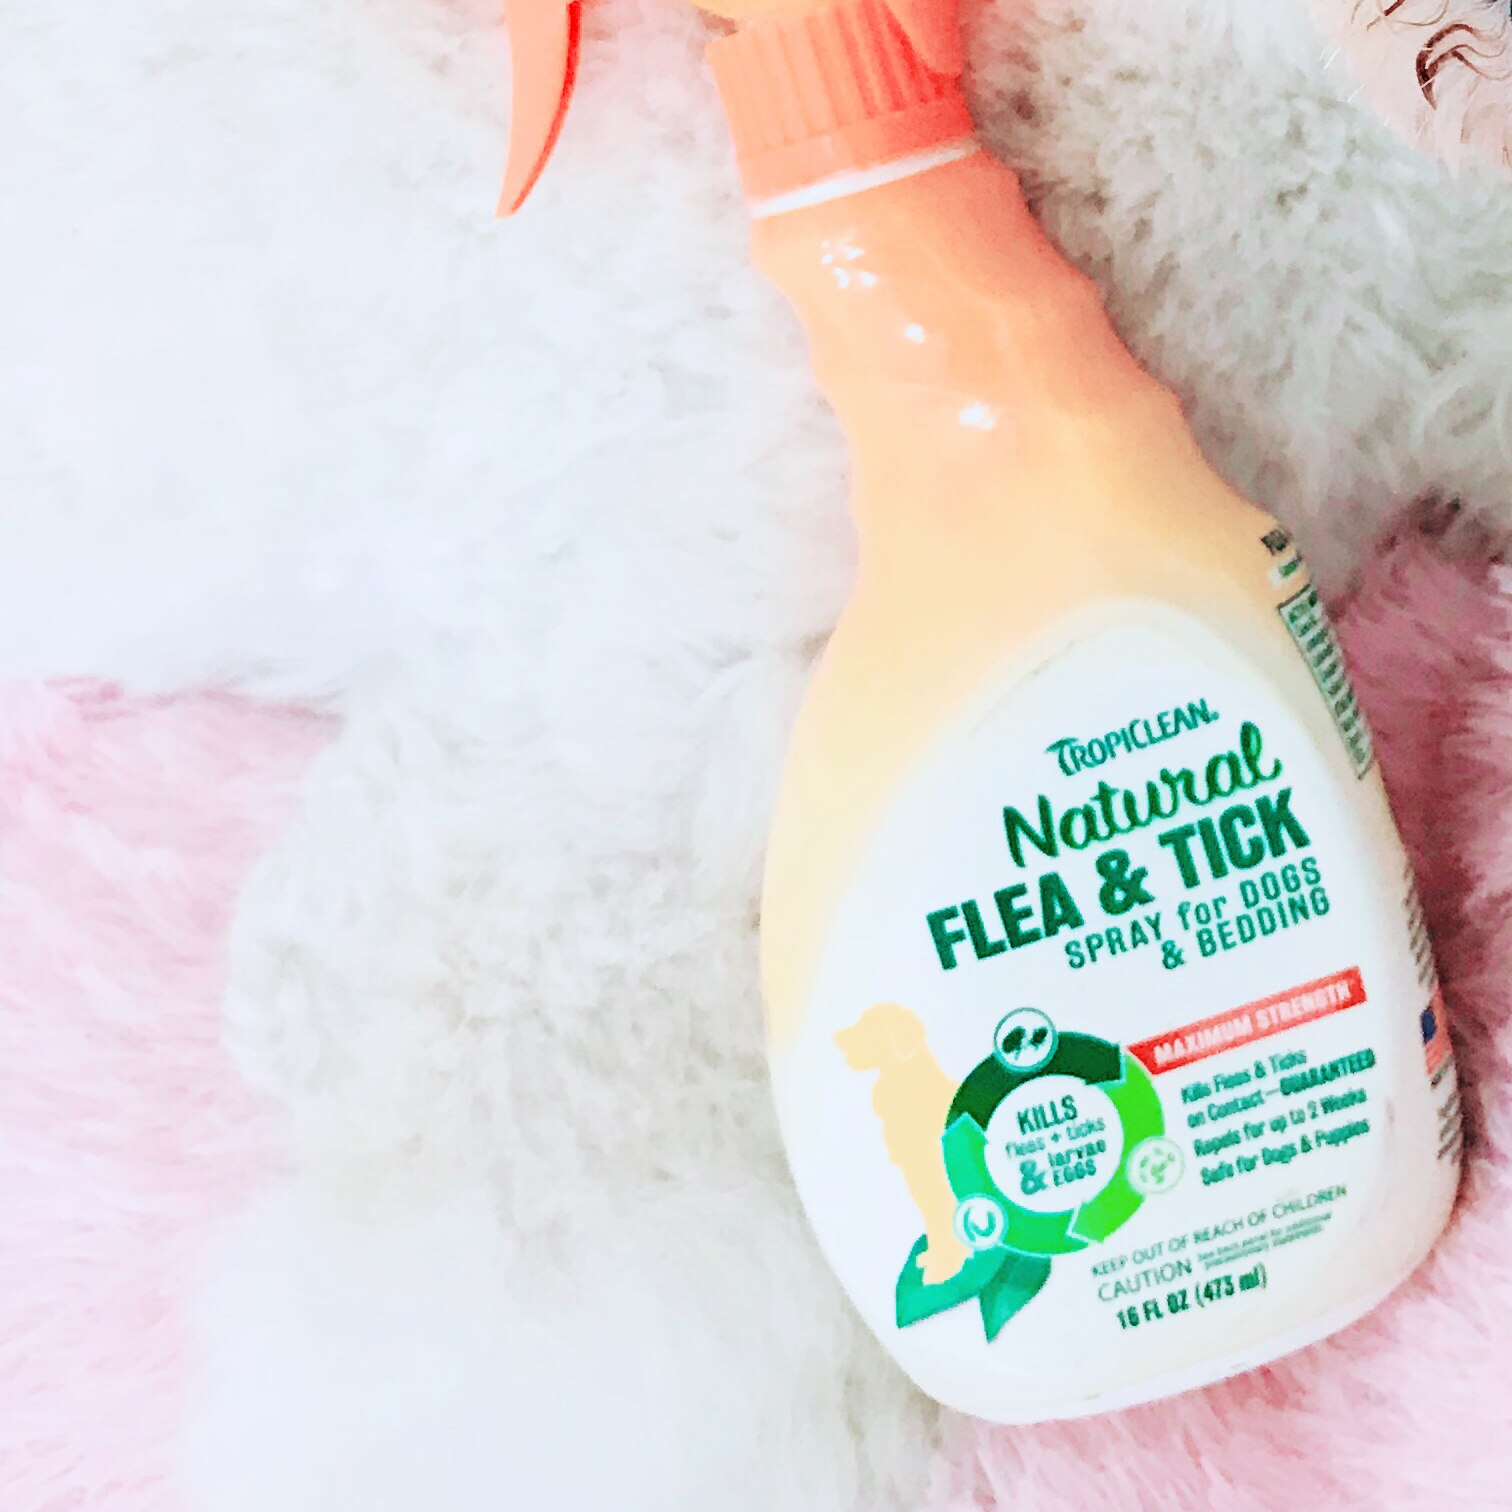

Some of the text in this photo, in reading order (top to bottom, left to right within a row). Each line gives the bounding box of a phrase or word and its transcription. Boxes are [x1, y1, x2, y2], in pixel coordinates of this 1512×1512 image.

[1003, 721, 1282, 868] Natural
[926, 787, 1310, 969] FLEA & TICK
[1064, 857, 1321, 968] SPRAY for DOGS
[1161, 887, 1330, 970] & BEDDING
[1154, 982, 1351, 1065] MAXIMUM STRENGTH
[1254, 1060, 1266, 1079] &
[1017, 1094, 1078, 1135] KILLS
[1187, 1111, 1205, 1128] on
[1243, 1120, 1265, 1141] for
[1269, 1114, 1287, 1134] up
[1289, 1108, 1305, 1125] to
[1307, 1100, 1318, 1119] 2
[1053, 1158, 1097, 1187] EGGS
[1236, 1154, 1258, 1174] for
[1262, 1142, 1298, 1166] Dogs
[1300, 1134, 1312, 1153] &
[1020, 1160, 1048, 1195] &
[1091, 1255, 1128, 1277] KEEP
[1132, 1241, 1165, 1265] OUT
[1168, 1233, 1188, 1253] OF
[1193, 1217, 1244, 1244] REACH
[1247, 1208, 1267, 1227] OF
[1272, 1185, 1348, 1219] CHILDREN
[1098, 1257, 1193, 1302] CAUTION
[1117, 1305, 1140, 1330] 16
[1143, 1298, 1164, 1322] FL
[1167, 1288, 1191, 1314] OZ
[1195, 1274, 1235, 1308] (473
